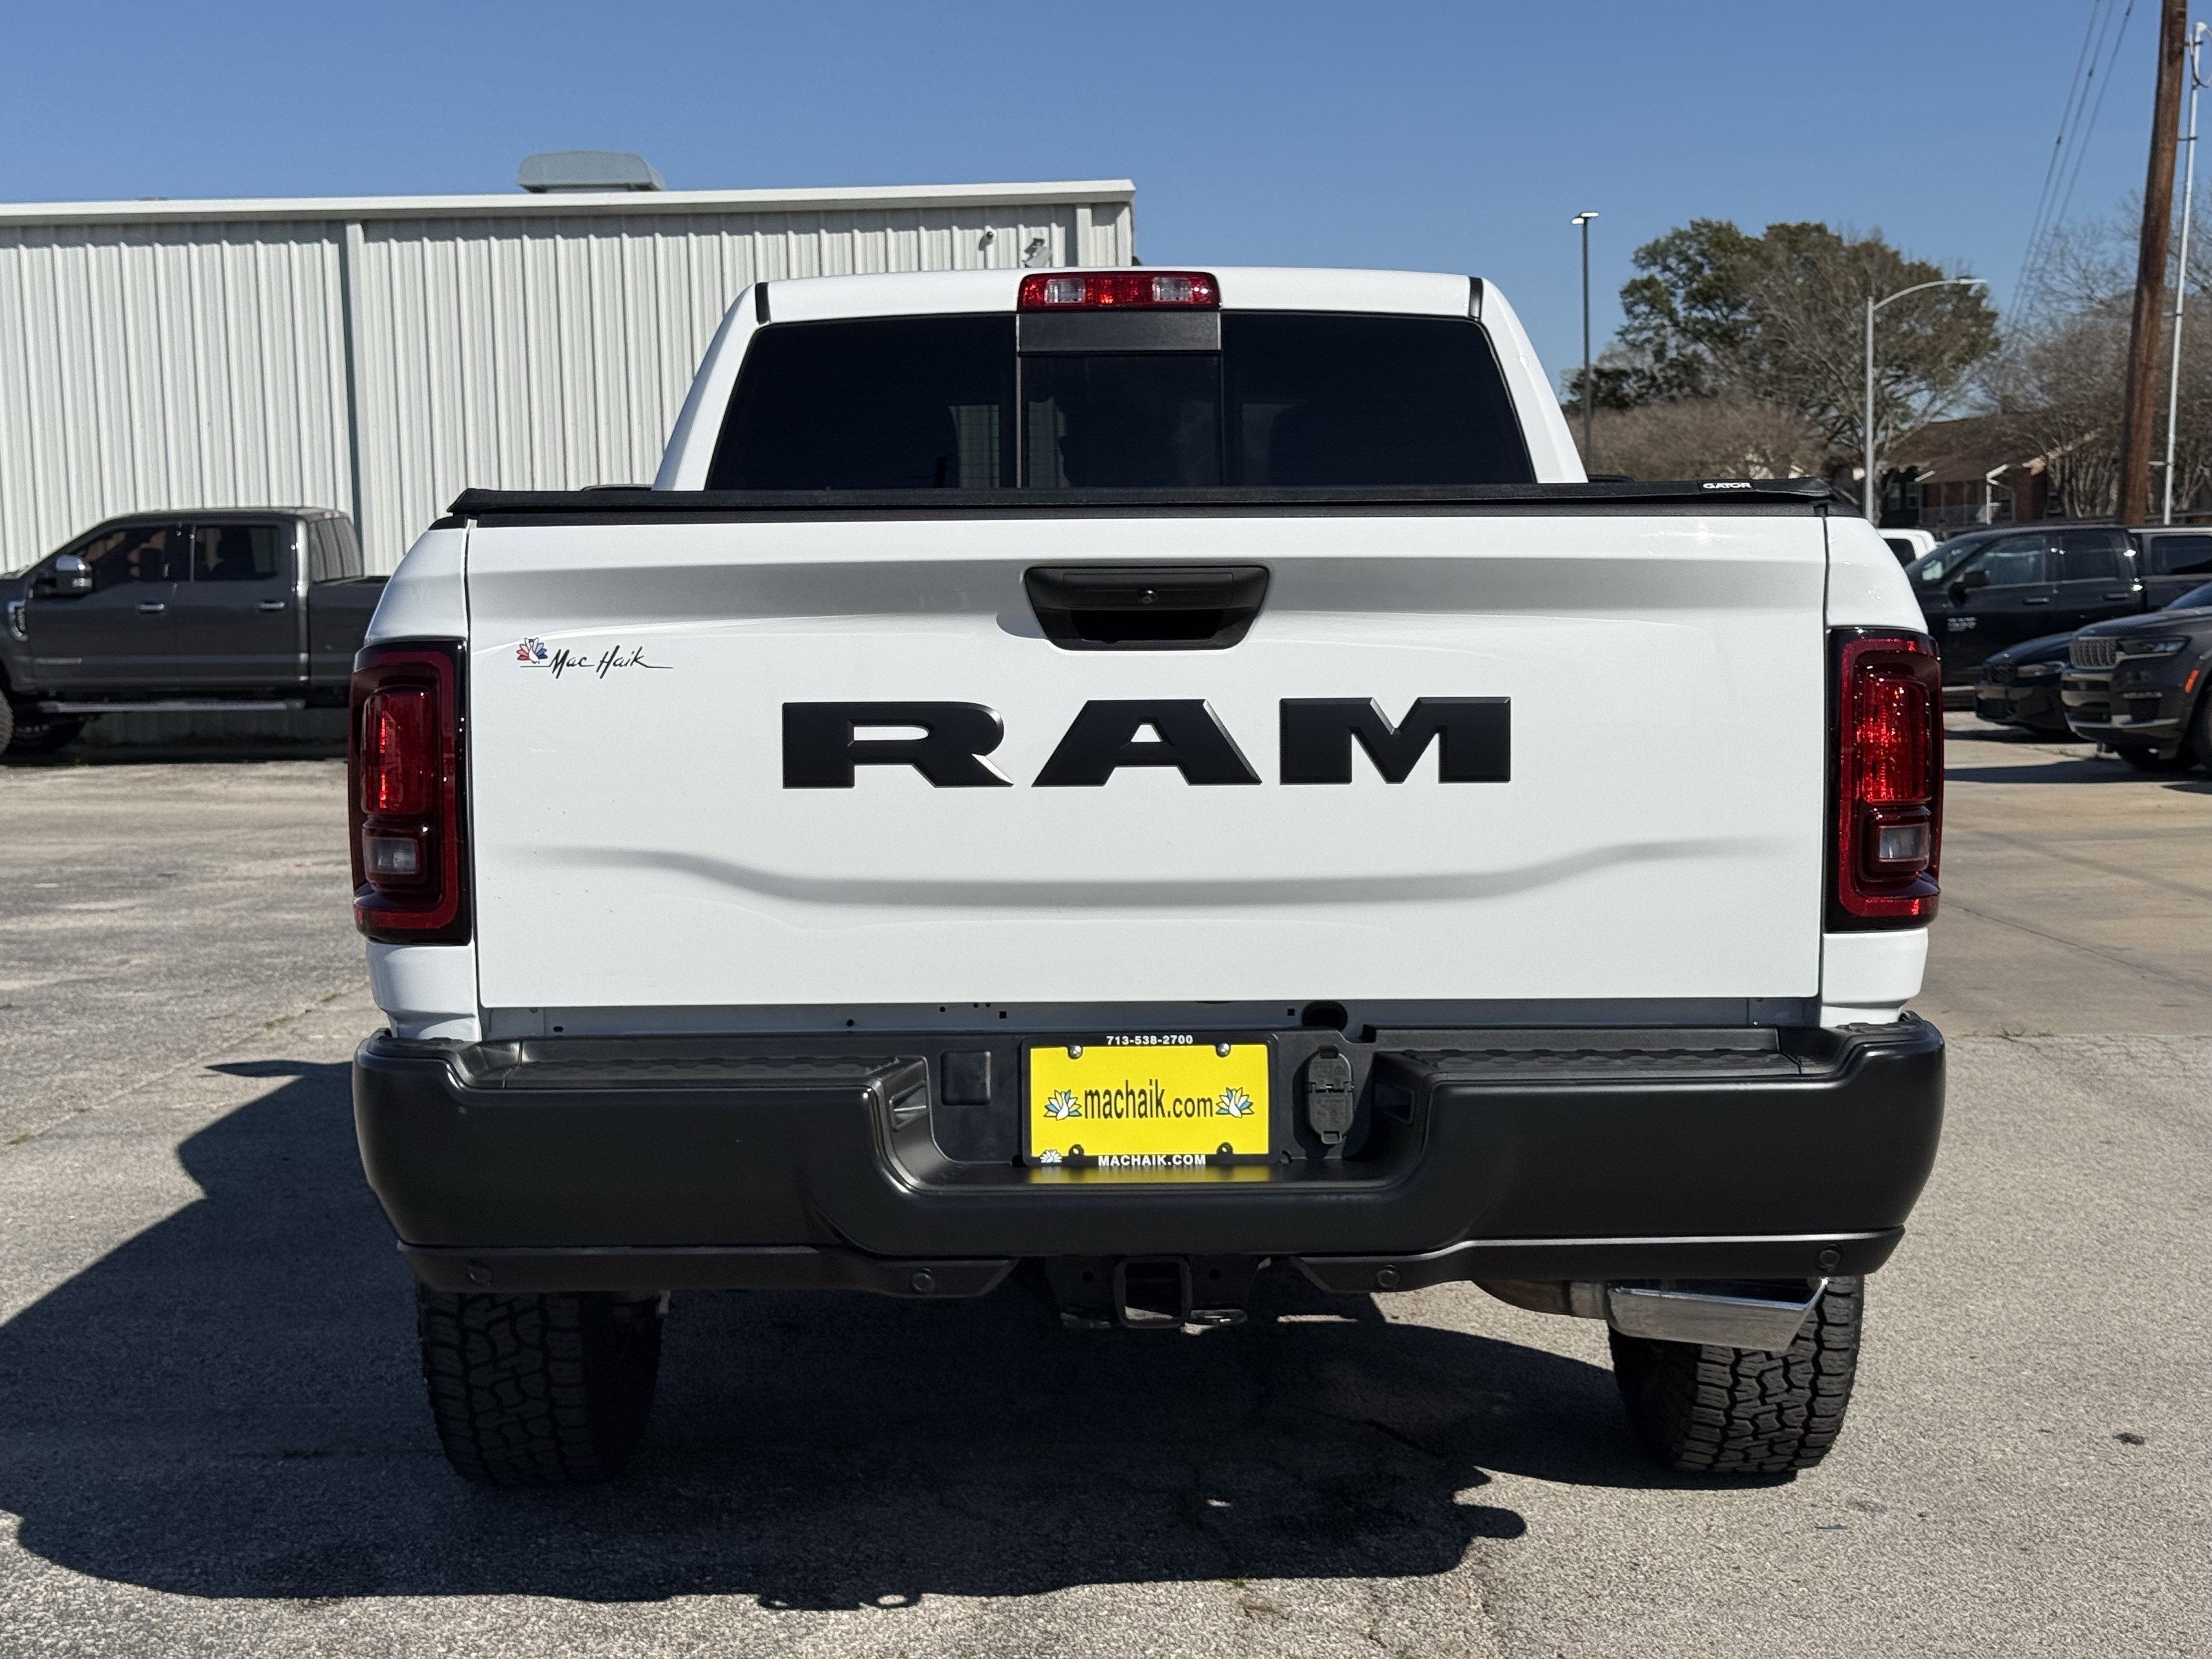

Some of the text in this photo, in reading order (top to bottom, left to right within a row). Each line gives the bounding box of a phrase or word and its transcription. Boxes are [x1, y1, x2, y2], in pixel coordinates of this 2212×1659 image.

[549, 645, 673, 679] Mac Haik
[782, 697, 1511, 788] RAM
[1107, 1035, 1193, 1045] 713-538-2700
[1084, 1079, 1214, 1120] machaik.com
[1098, 1154, 1206, 1166] MACHAIK.COM
